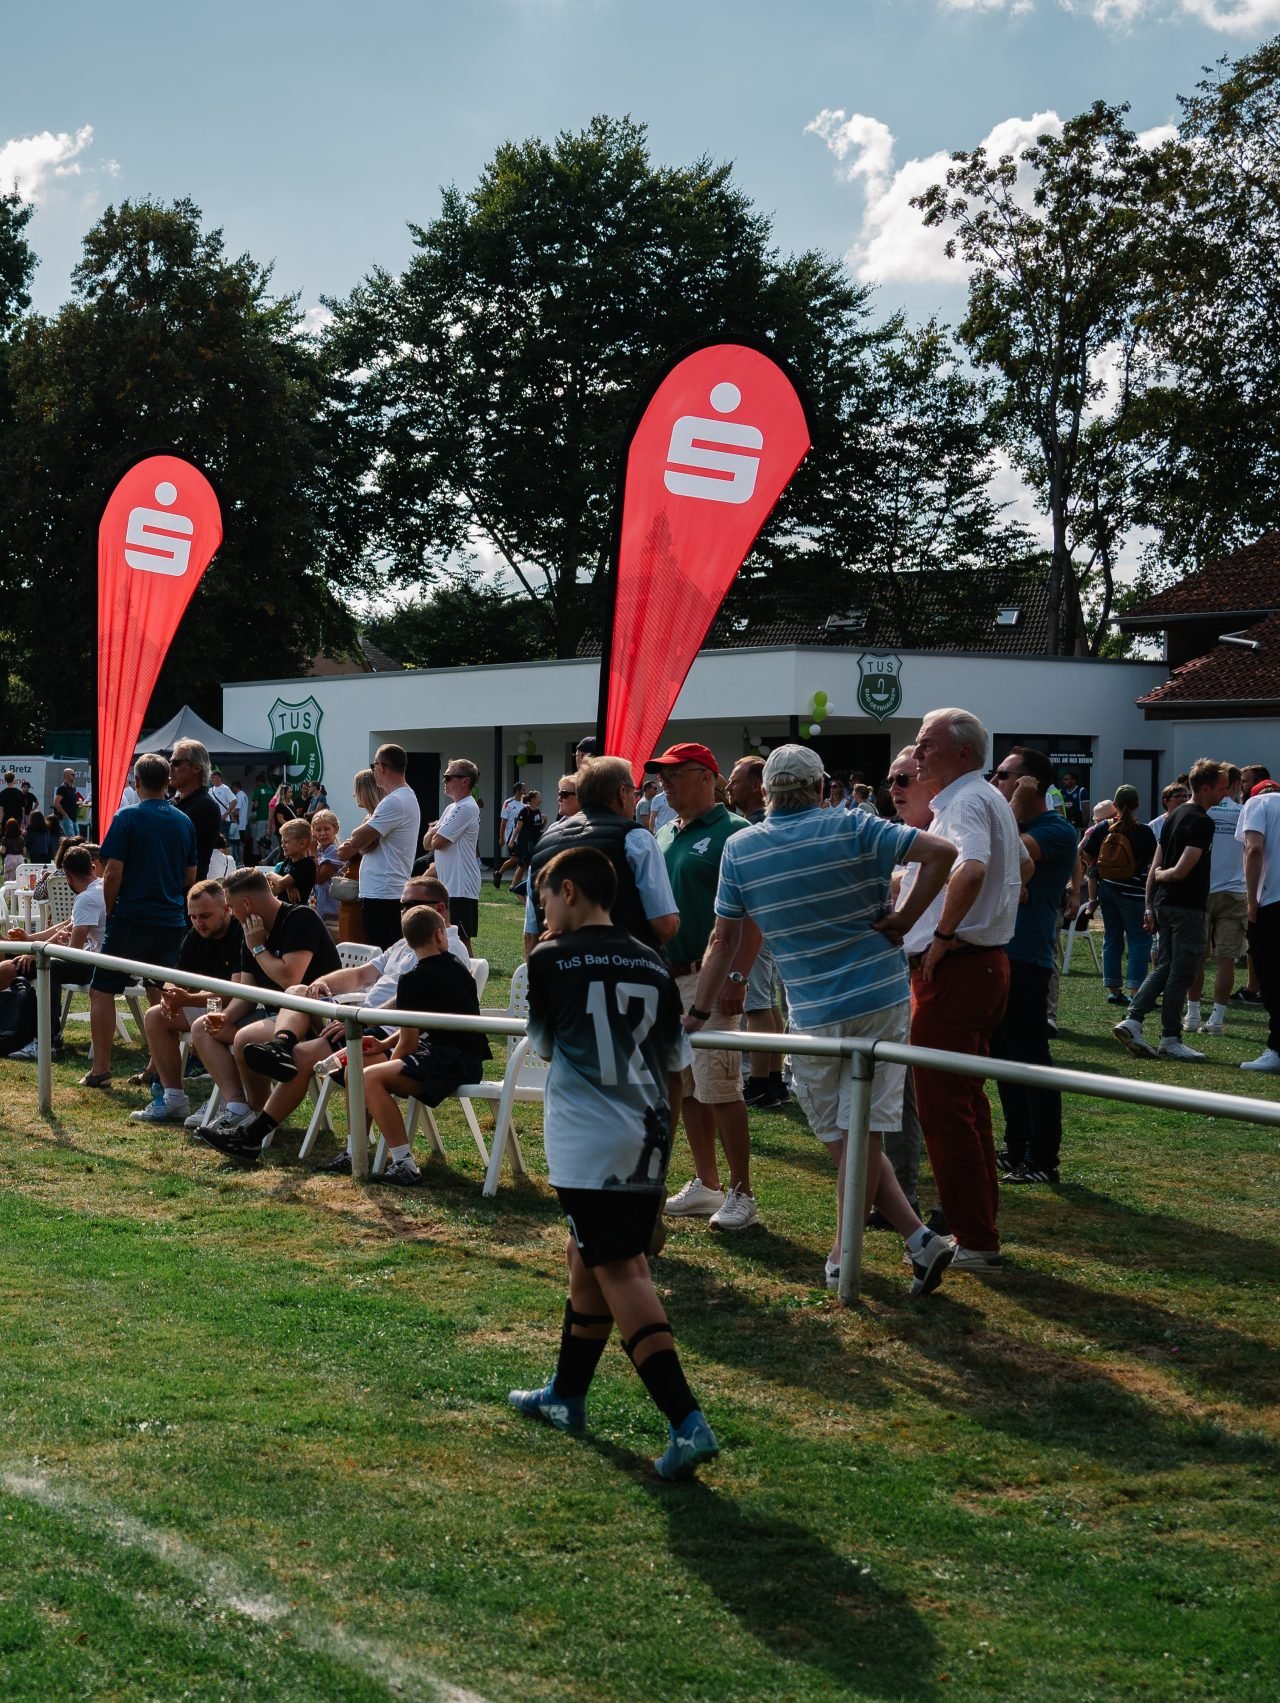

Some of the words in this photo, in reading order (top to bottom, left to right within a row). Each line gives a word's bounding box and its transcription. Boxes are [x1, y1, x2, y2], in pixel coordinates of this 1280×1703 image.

[867, 662, 893, 673] TUS
[279, 712, 311, 731] TUS
[1, 765, 7, 773] &
[9, 765, 32, 773] Bretz
[692, 837, 712, 854] 4
[556, 956, 582, 971] TuS
[585, 954, 609, 966] Bad
[586, 981, 659, 1086] 12
